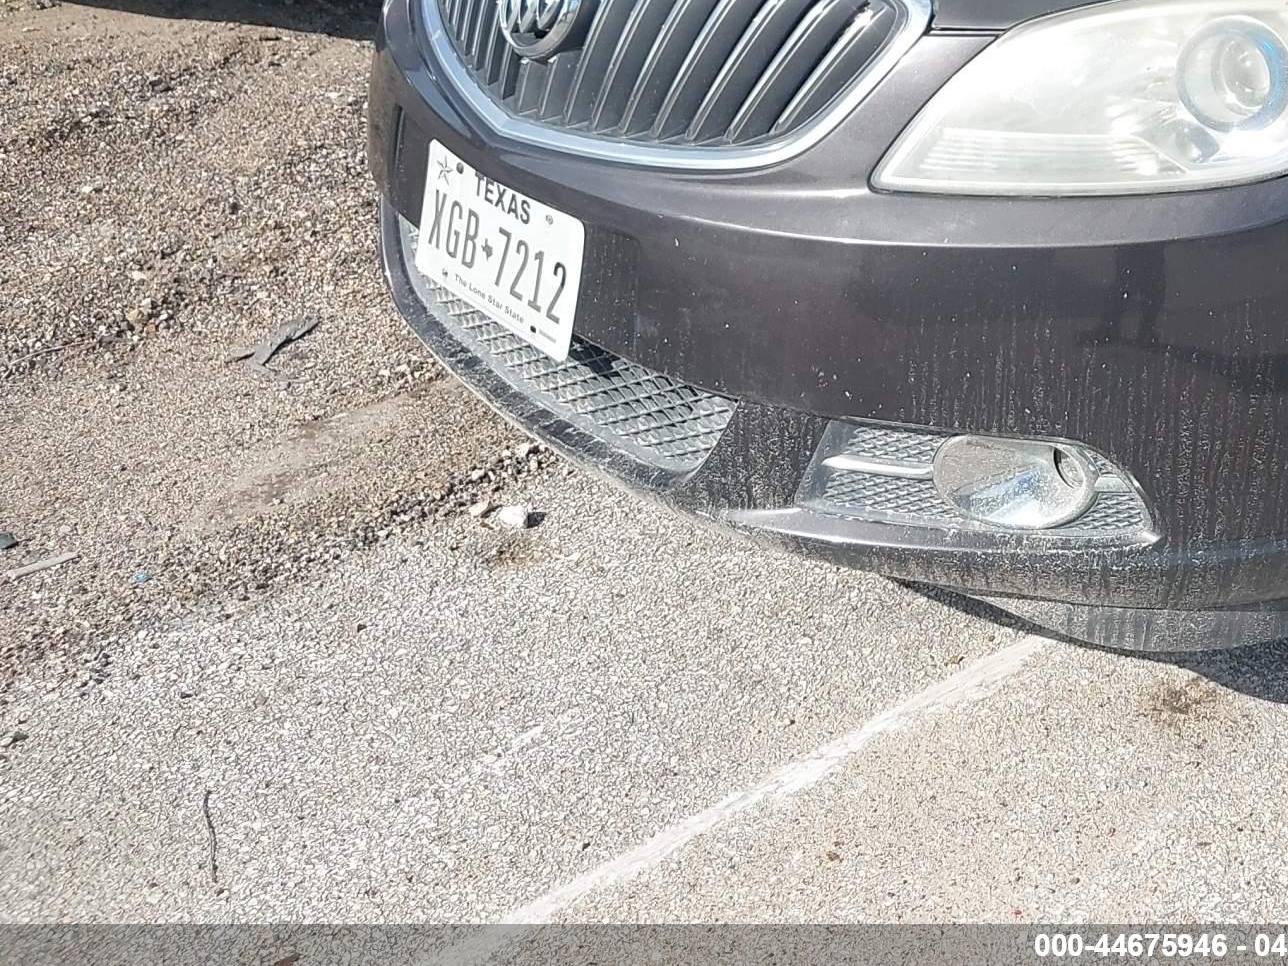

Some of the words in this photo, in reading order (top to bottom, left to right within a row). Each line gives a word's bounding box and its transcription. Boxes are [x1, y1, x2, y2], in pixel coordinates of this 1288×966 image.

[475, 170, 531, 225] TEXAS
[455, 274, 467, 288] The
[468, 283, 486, 301] Lone
[487, 294, 503, 311] Star
[504, 305, 525, 324] State
